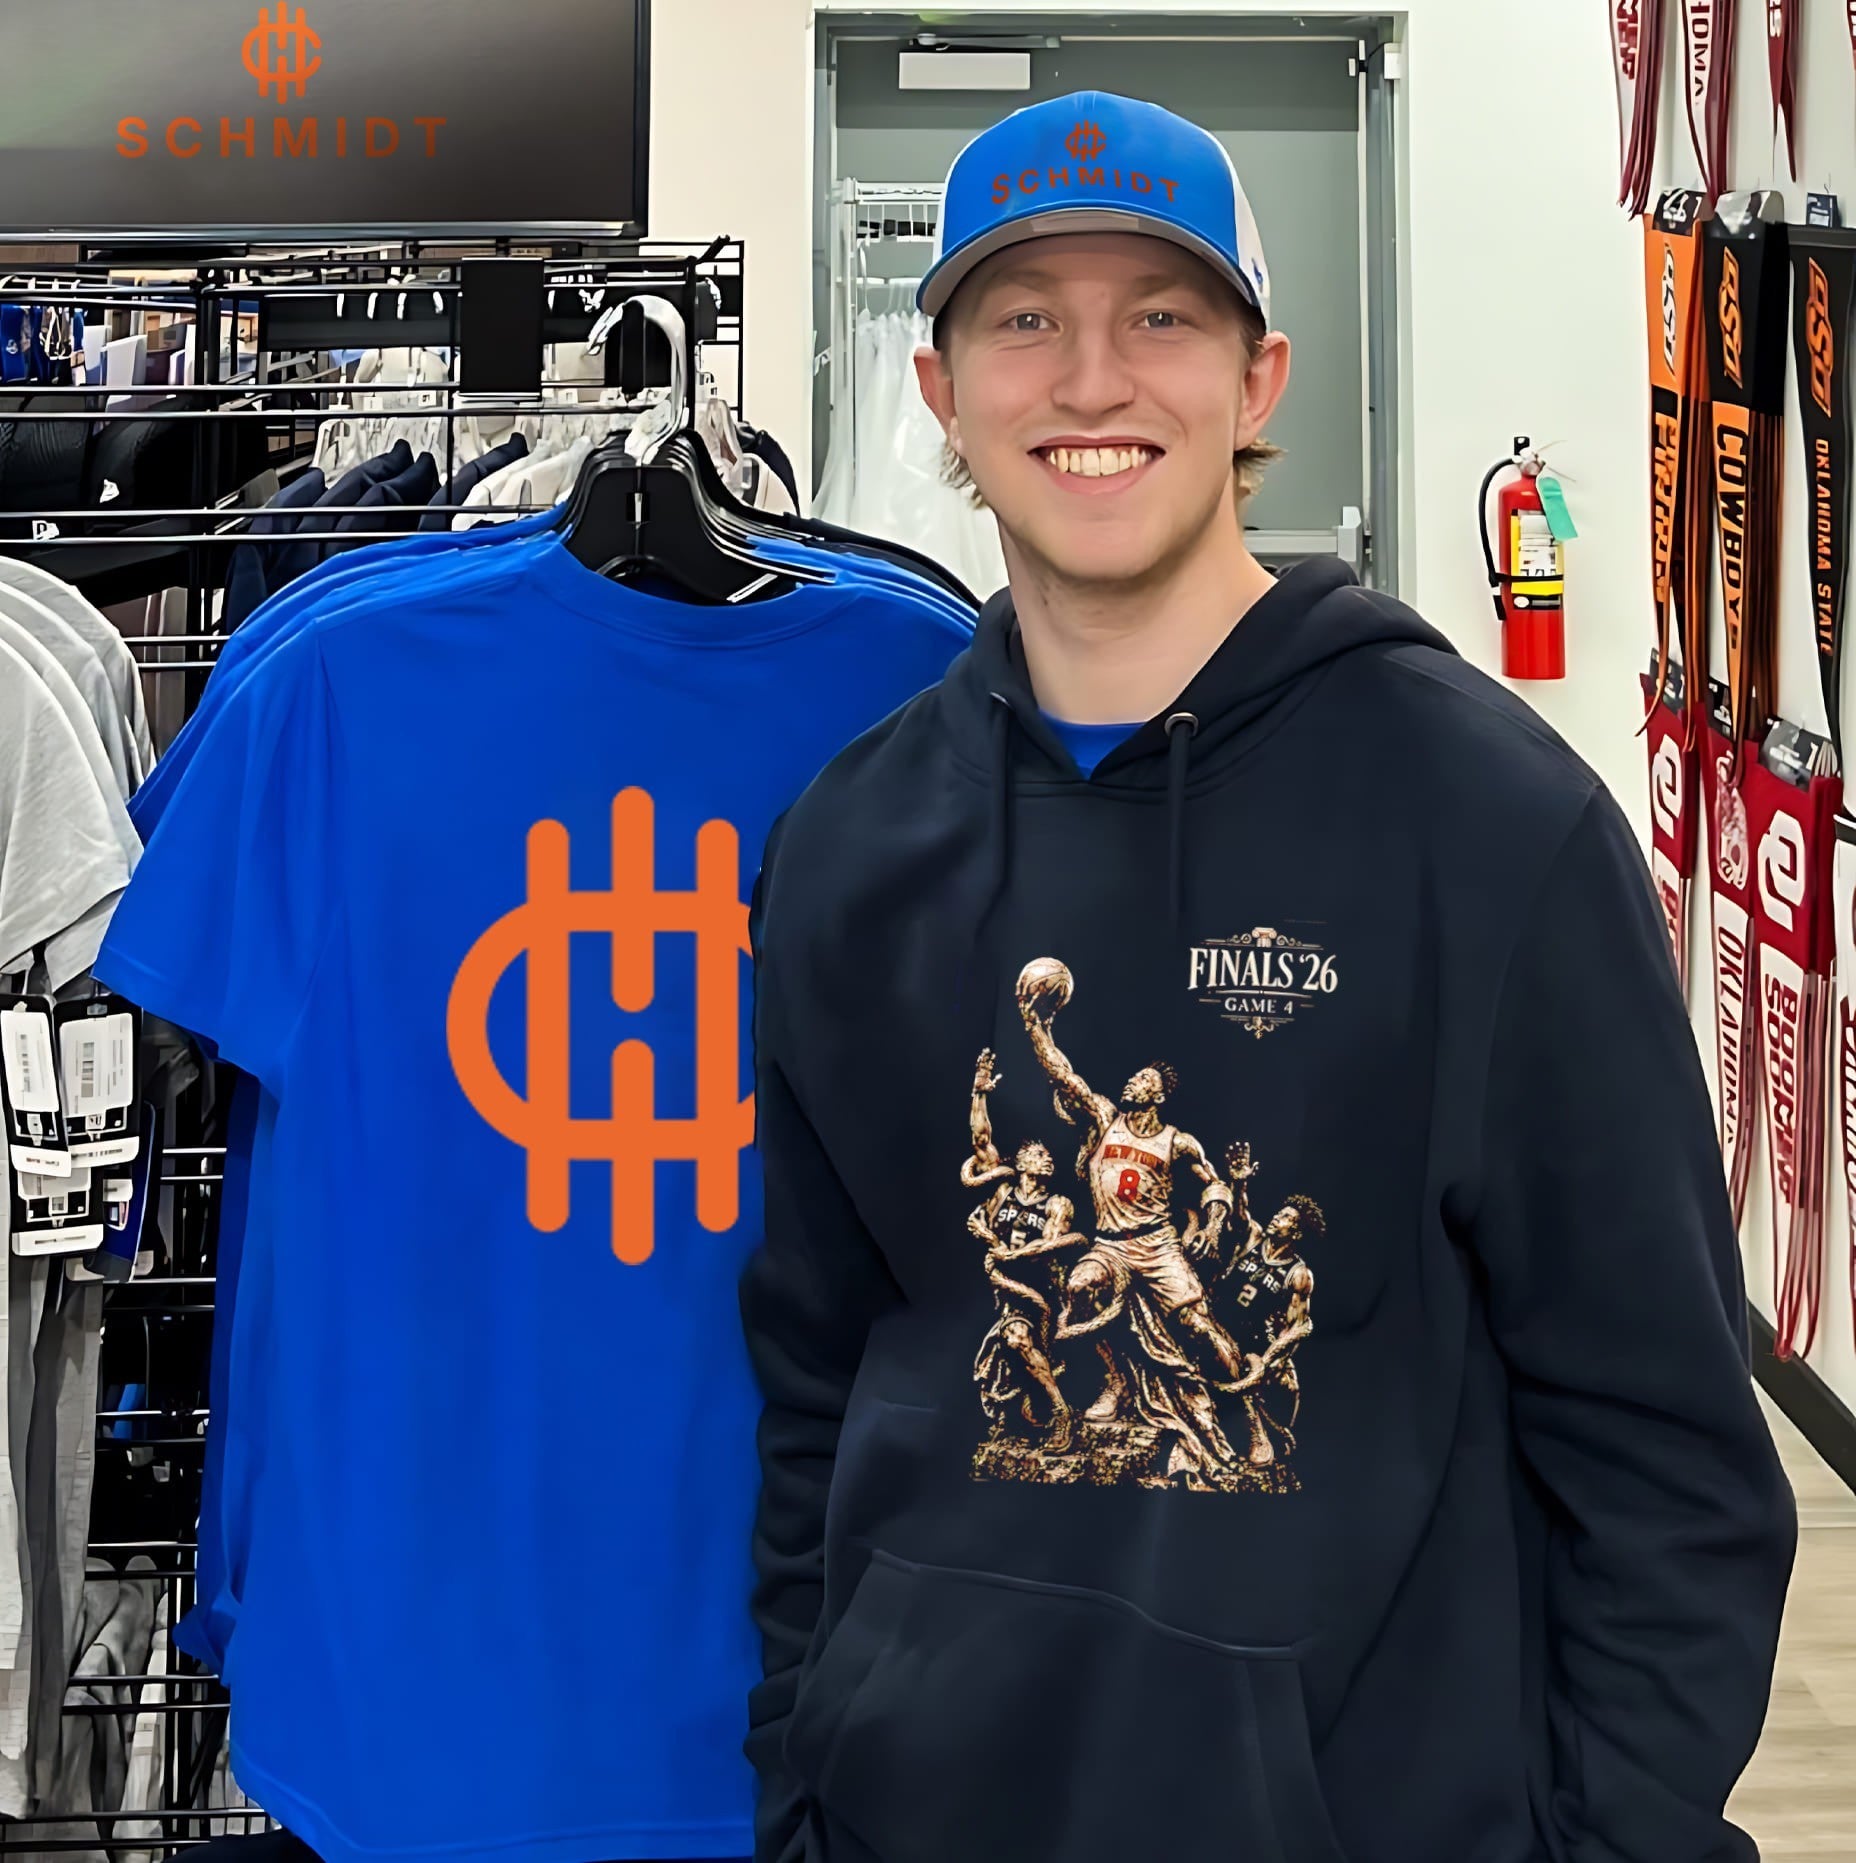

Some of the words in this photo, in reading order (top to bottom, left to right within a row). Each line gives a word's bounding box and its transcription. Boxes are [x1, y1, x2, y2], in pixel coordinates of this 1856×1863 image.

[116, 116, 448, 158] SCHMIDT
[991, 166, 1180, 205] SCHMIDT
[1187, 947, 1294, 991] FINALS
[1299, 953, 1338, 994] '26
[1224, 997, 1277, 1014] GAME
[1283, 1000, 1294, 1015] 4
[1116, 1168, 1142, 1204] 8
[997, 1208, 1047, 1232] SPRS
[1009, 1229, 1027, 1251] 5
[1237, 1259, 1282, 1294] SPRS
[1236, 1283, 1258, 1308] 2
